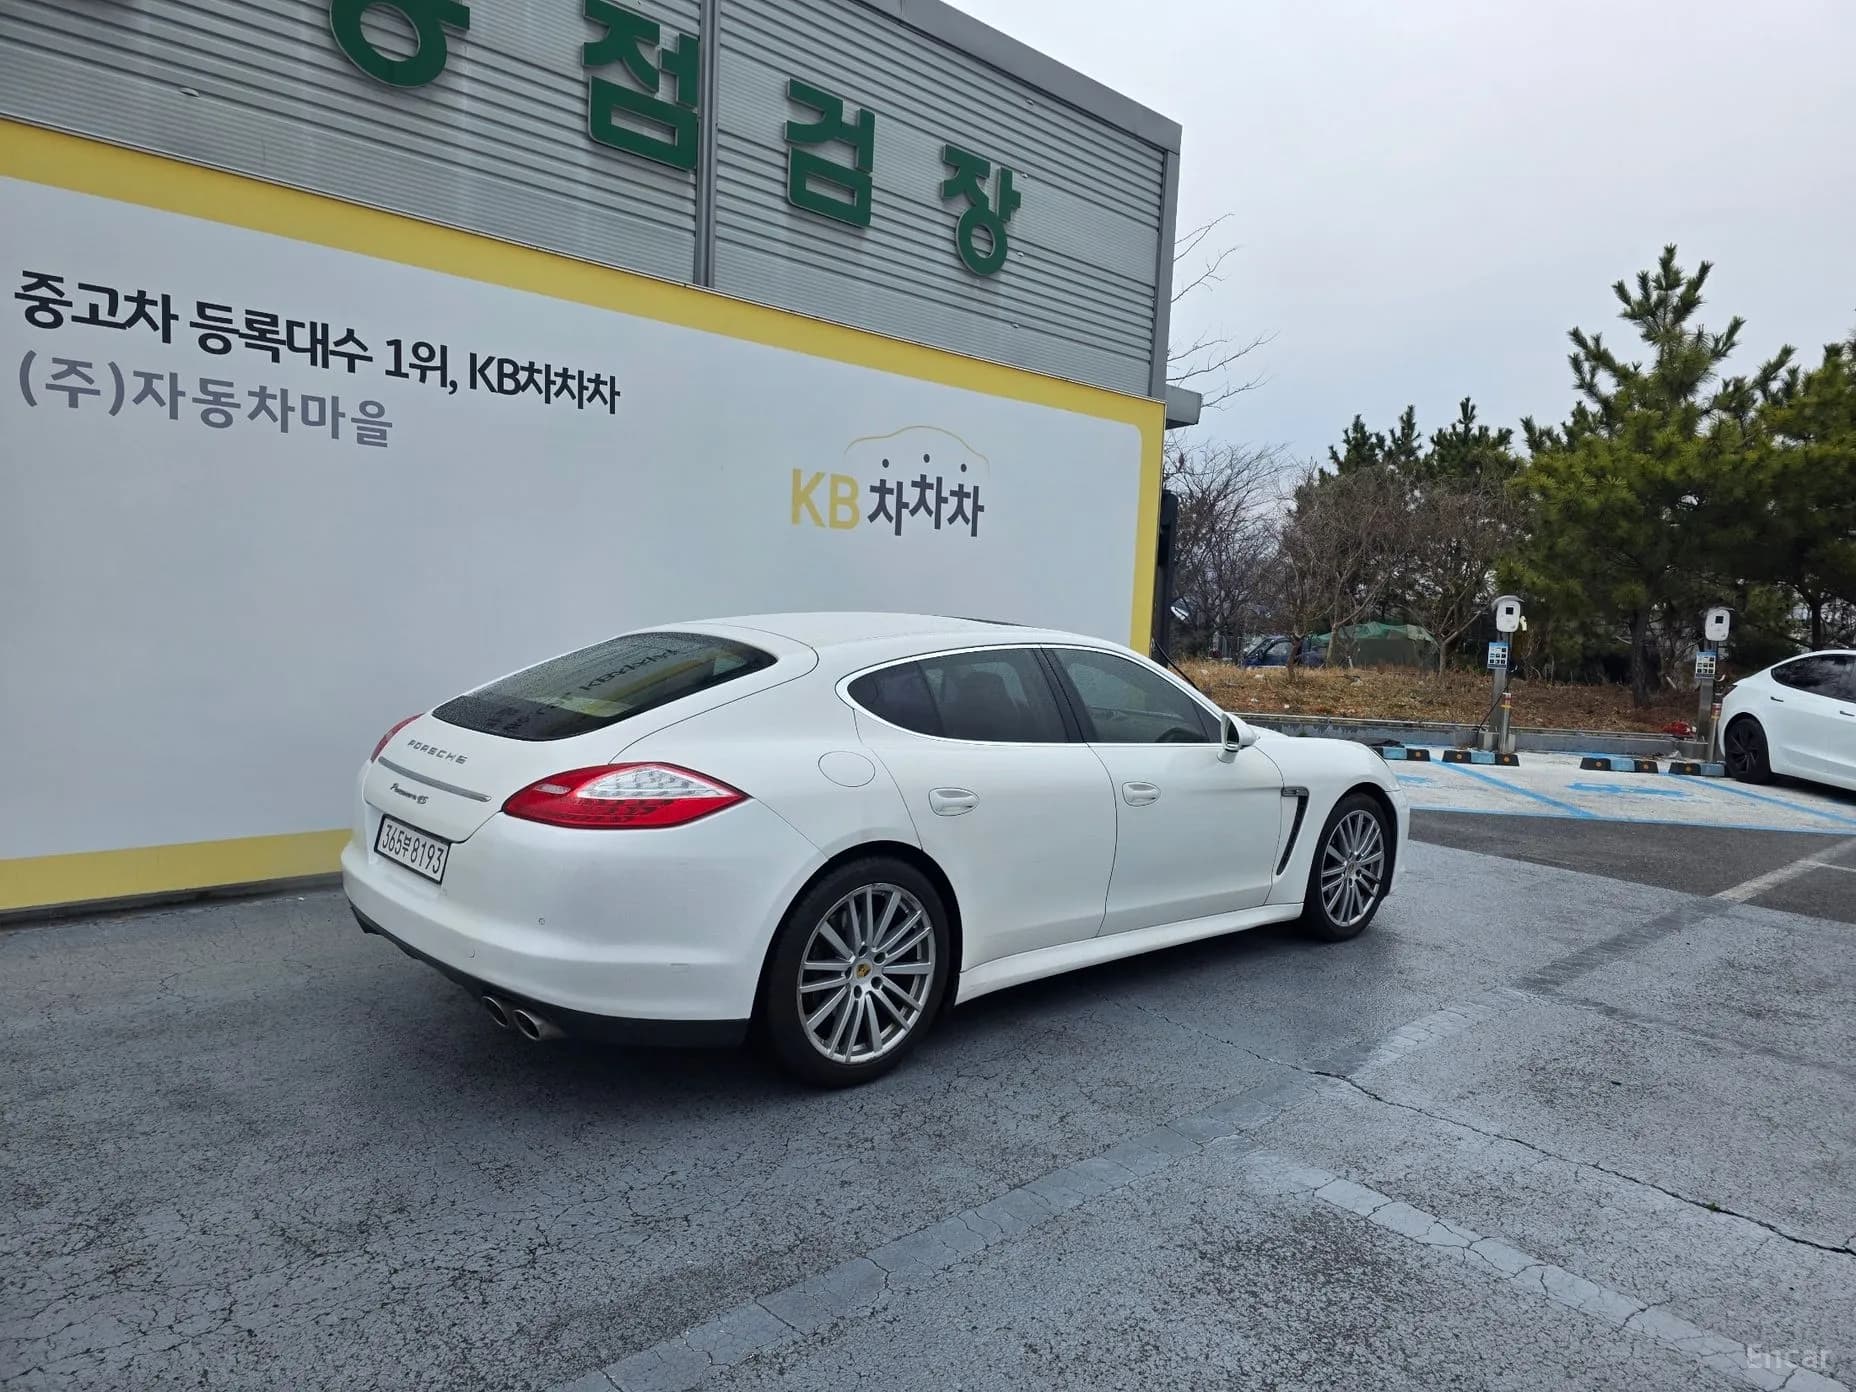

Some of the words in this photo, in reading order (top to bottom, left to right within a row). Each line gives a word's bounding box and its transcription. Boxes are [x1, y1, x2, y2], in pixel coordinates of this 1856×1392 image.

[14, 269, 180, 345] 중고차
[189, 300, 374, 374] 등록대수
[384, 337, 459, 396] 1위,
[469, 351, 622, 415] KB차차차
[18, 349, 394, 448] (주)자동차마을
[407, 739, 468, 765] PORSCHE
[382, 823, 445, 874] 365부8193
